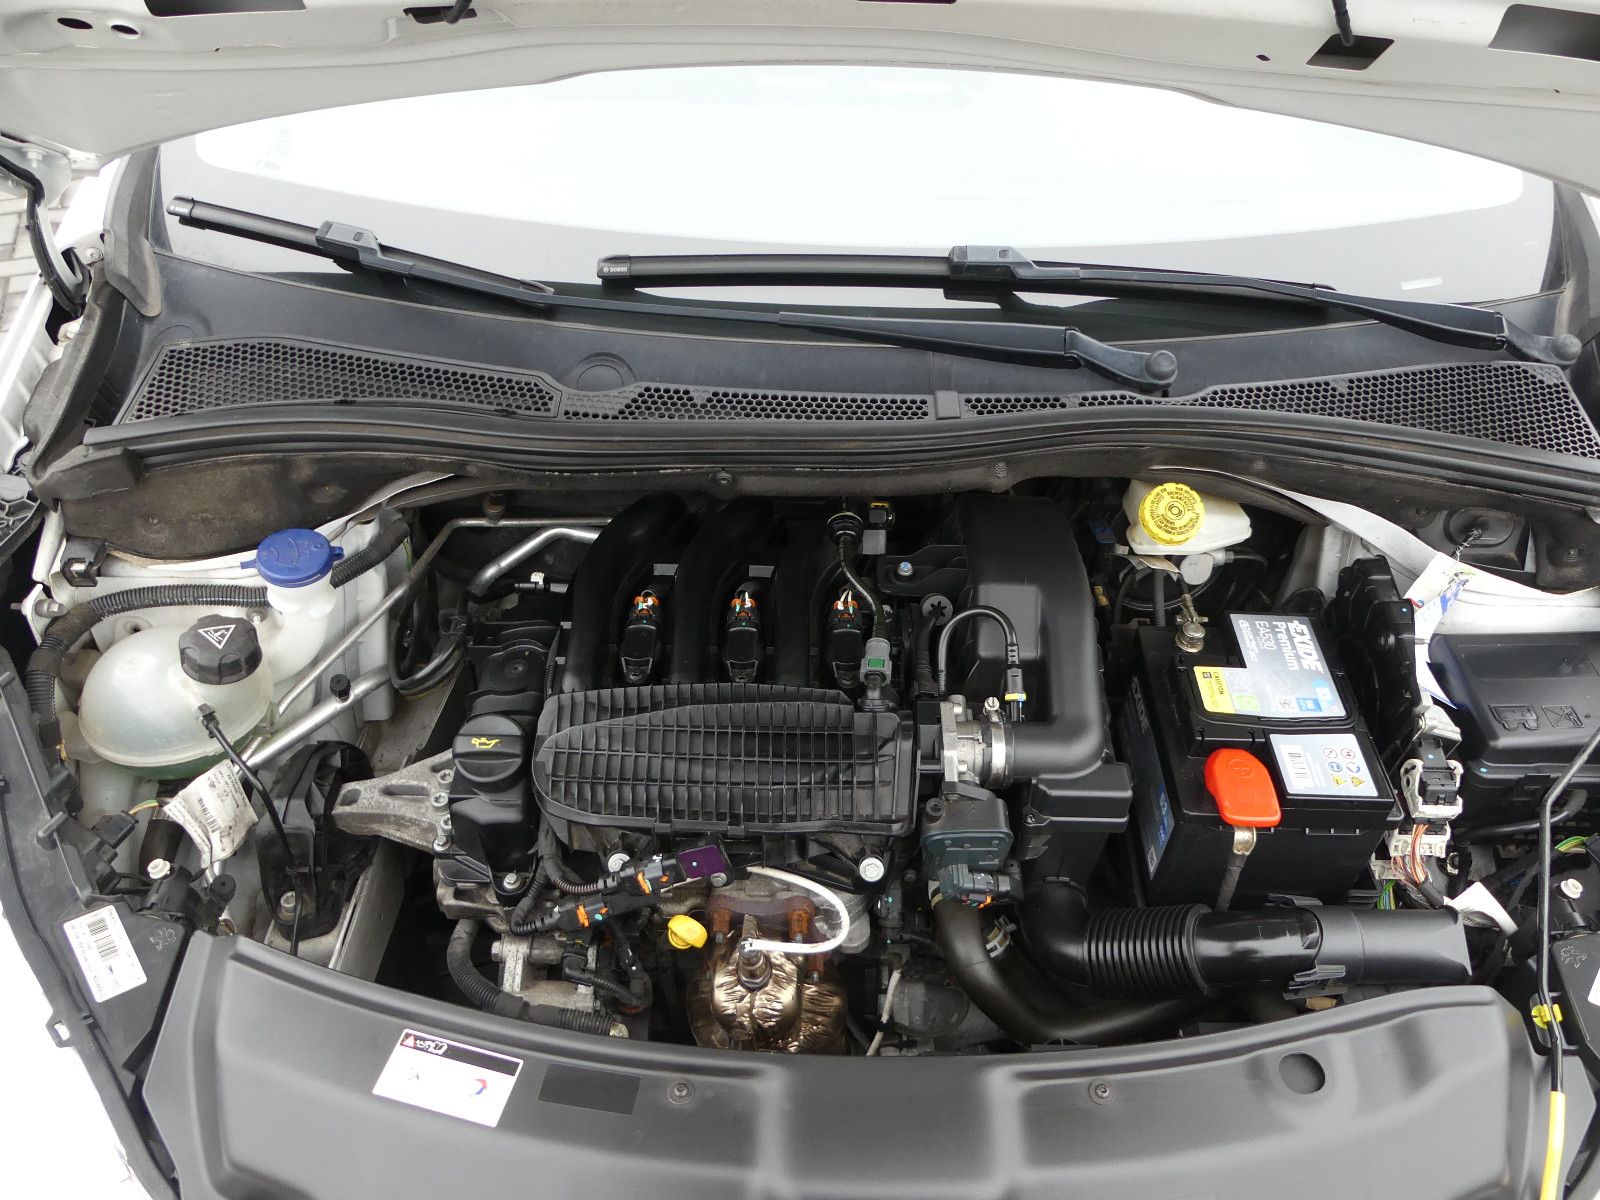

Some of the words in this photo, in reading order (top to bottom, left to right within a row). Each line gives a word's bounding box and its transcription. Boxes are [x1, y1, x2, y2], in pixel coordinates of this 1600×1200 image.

[1255, 620, 1277, 650] EA530
[1272, 620, 1299, 671] Premium
[1287, 619, 1324, 674] EXIDE
